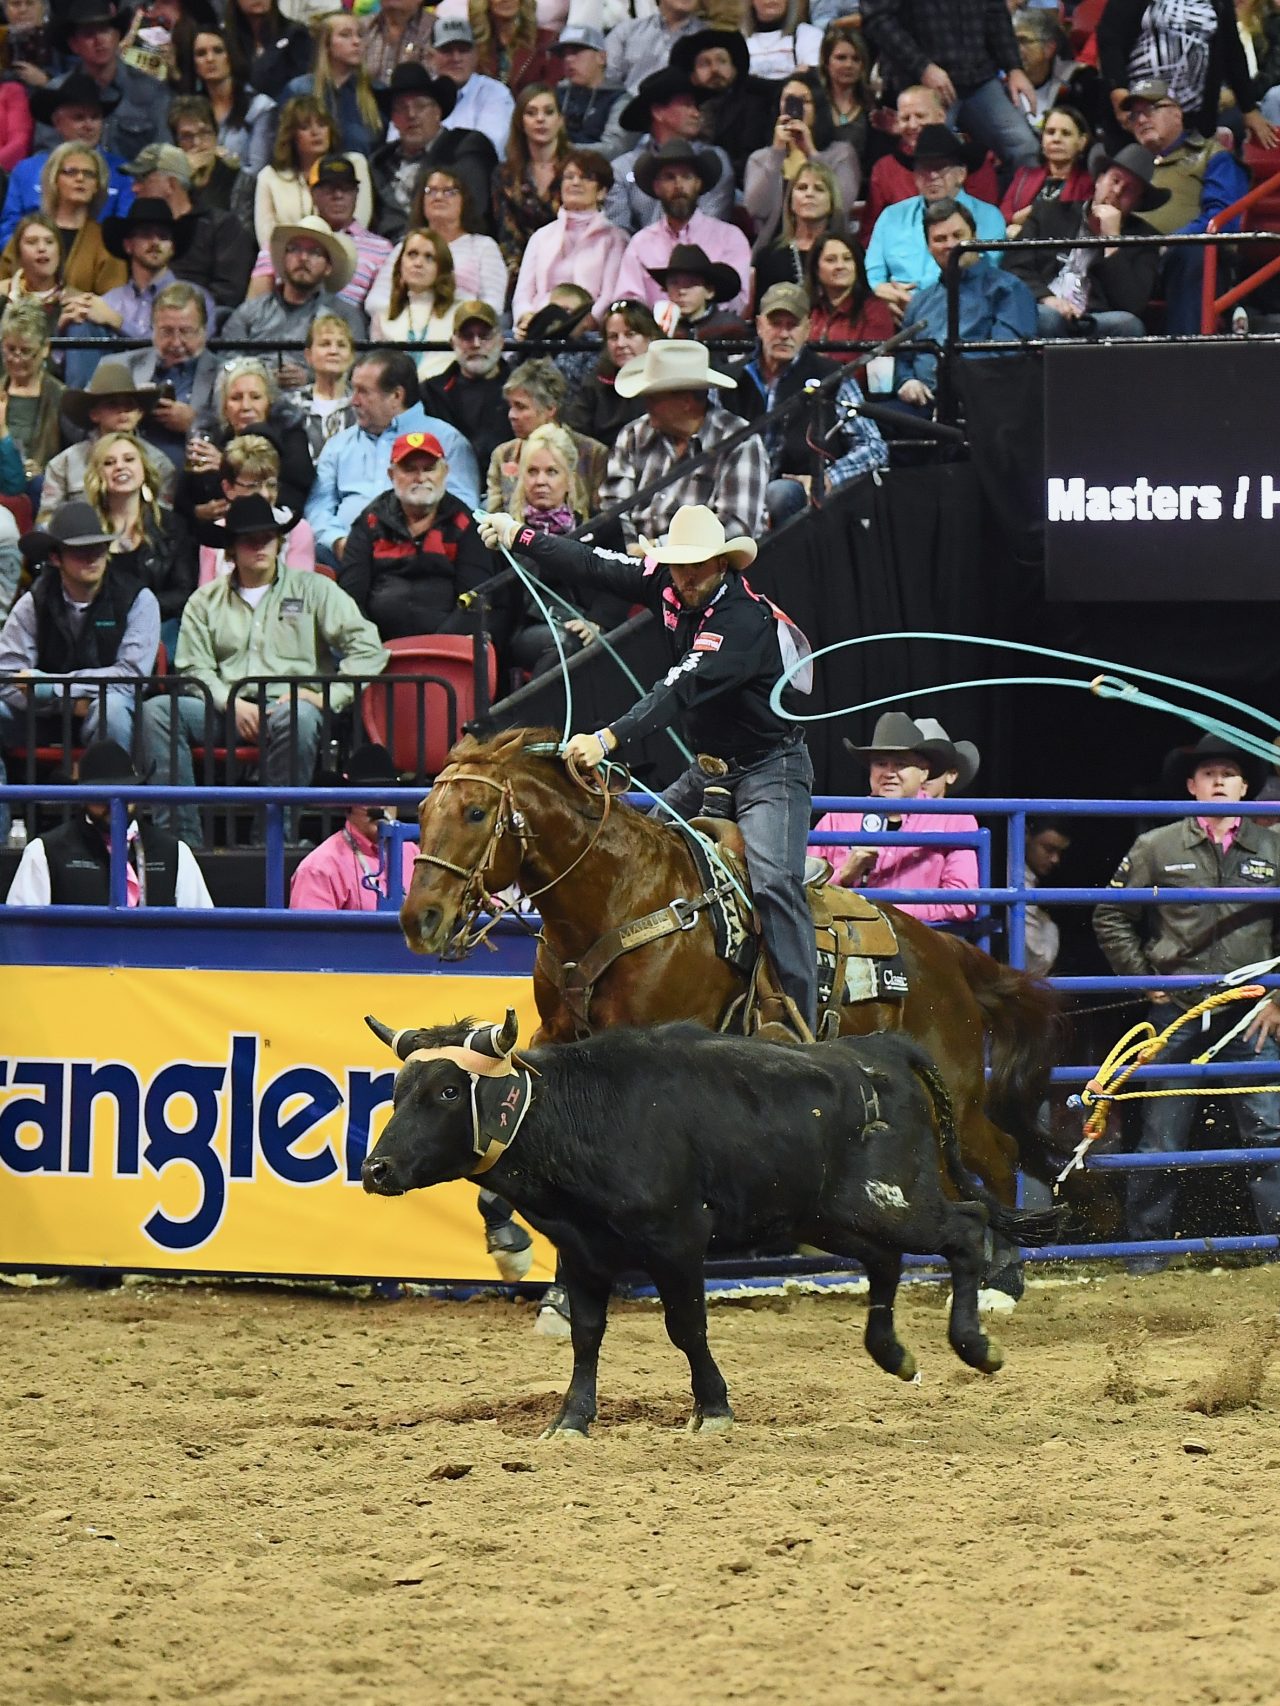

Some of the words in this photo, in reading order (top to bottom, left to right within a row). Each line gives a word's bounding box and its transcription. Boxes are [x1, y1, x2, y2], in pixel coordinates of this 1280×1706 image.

[1047, 477, 1222, 522] Masters
[1232, 475, 1251, 520] /
[0, 1036, 397, 1250] angler
